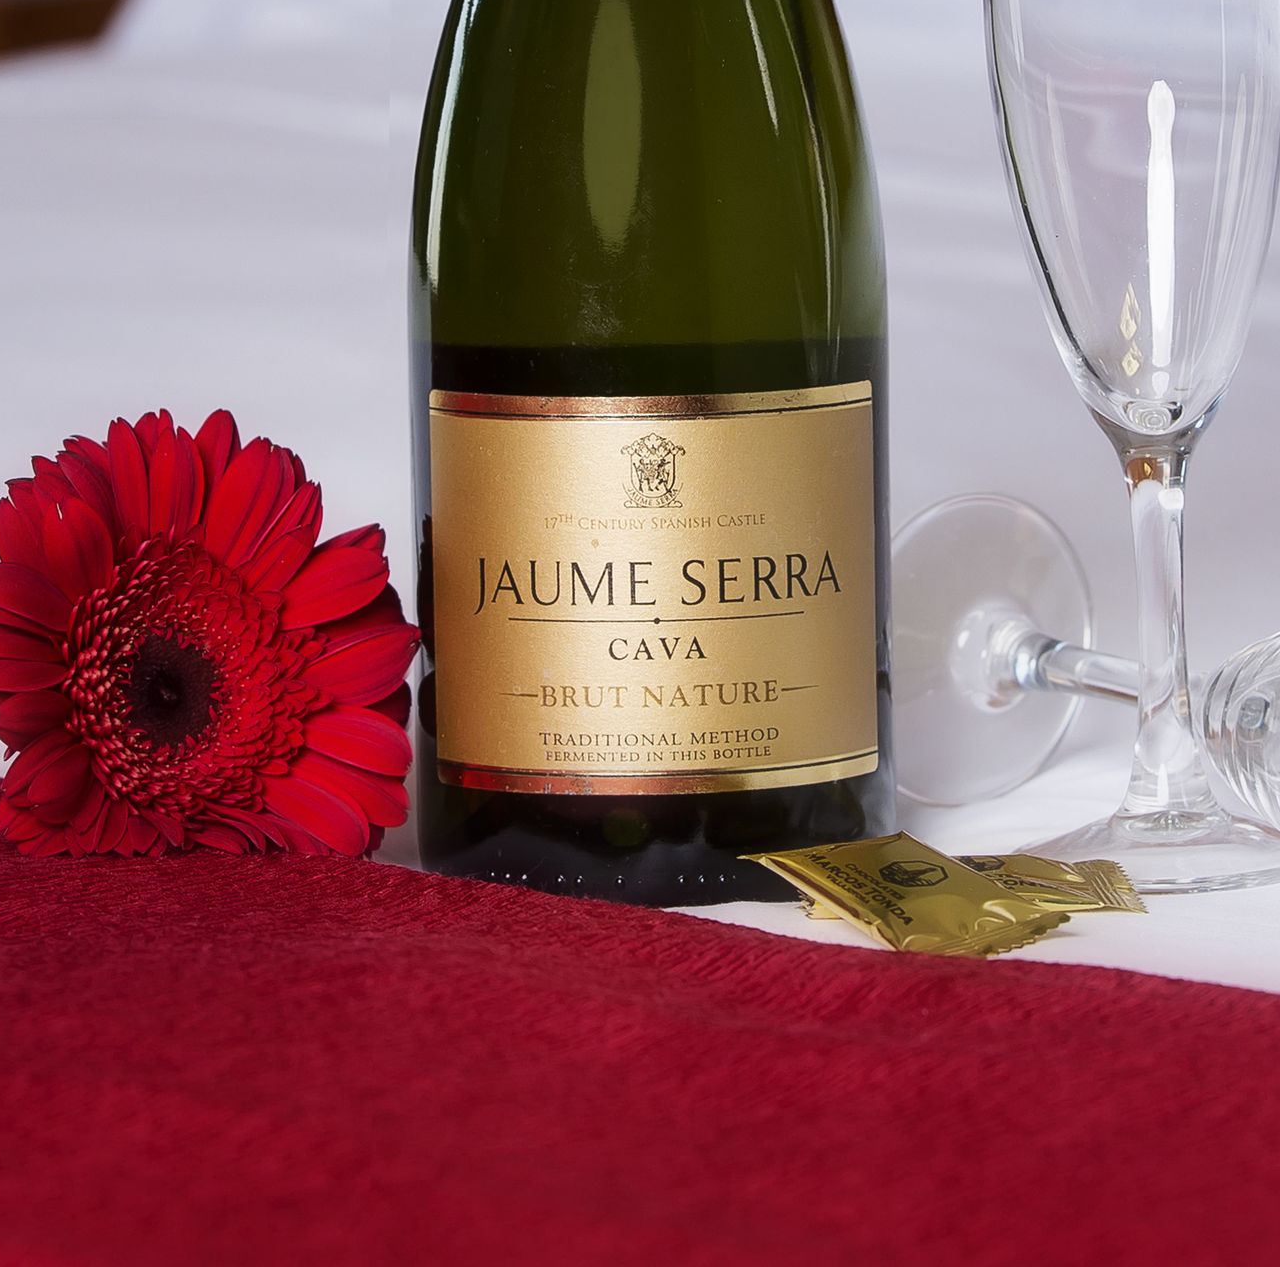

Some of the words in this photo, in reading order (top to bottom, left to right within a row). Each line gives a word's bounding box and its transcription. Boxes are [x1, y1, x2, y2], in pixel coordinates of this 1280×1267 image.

[627, 488, 653, 506] JAUME
[473, 556, 658, 615] JAUME
[680, 549, 843, 606] SERRA
[608, 635, 708, 662] CAVA
[539, 684, 629, 709] BRUT
[642, 679, 780, 709] NATURE
[538, 732, 682, 747] TRADITIONAL
[690, 727, 780, 745] METHOD
[545, 750, 641, 762] FERMENTED
[646, 750, 664, 762] IN
[669, 749, 707, 761] THIS
[712, 745, 772, 760] BOTTLE
[804, 852, 869, 890] MARCOS
[864, 886, 915, 926] TONDA
